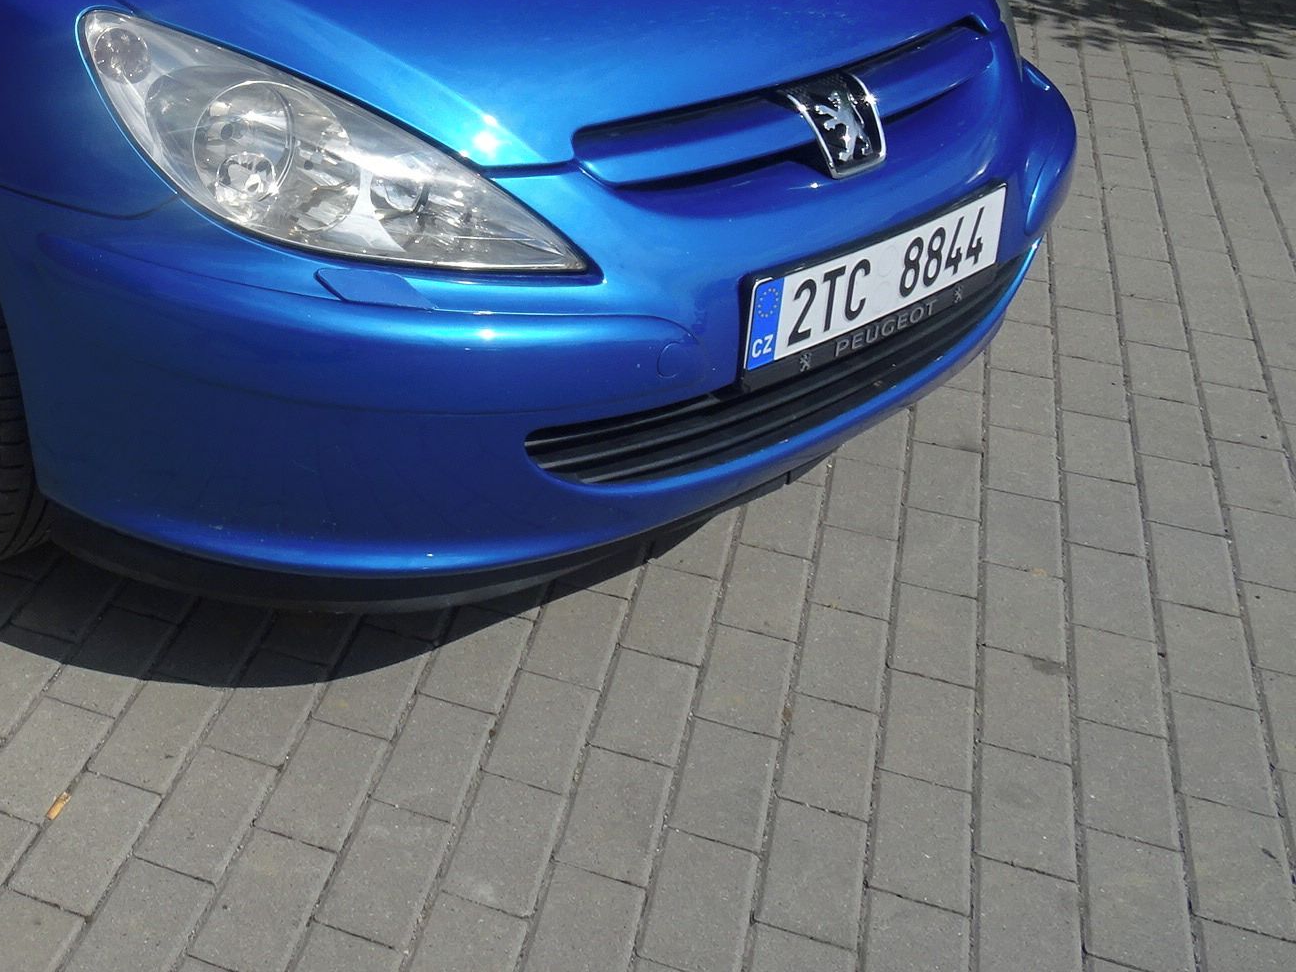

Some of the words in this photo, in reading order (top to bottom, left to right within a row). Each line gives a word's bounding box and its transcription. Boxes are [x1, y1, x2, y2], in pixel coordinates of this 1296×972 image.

[787, 258, 872, 347] 2TC
[899, 206, 986, 298] 8844
[751, 334, 775, 359] CZ
[835, 299, 939, 358] PEUGEOT
